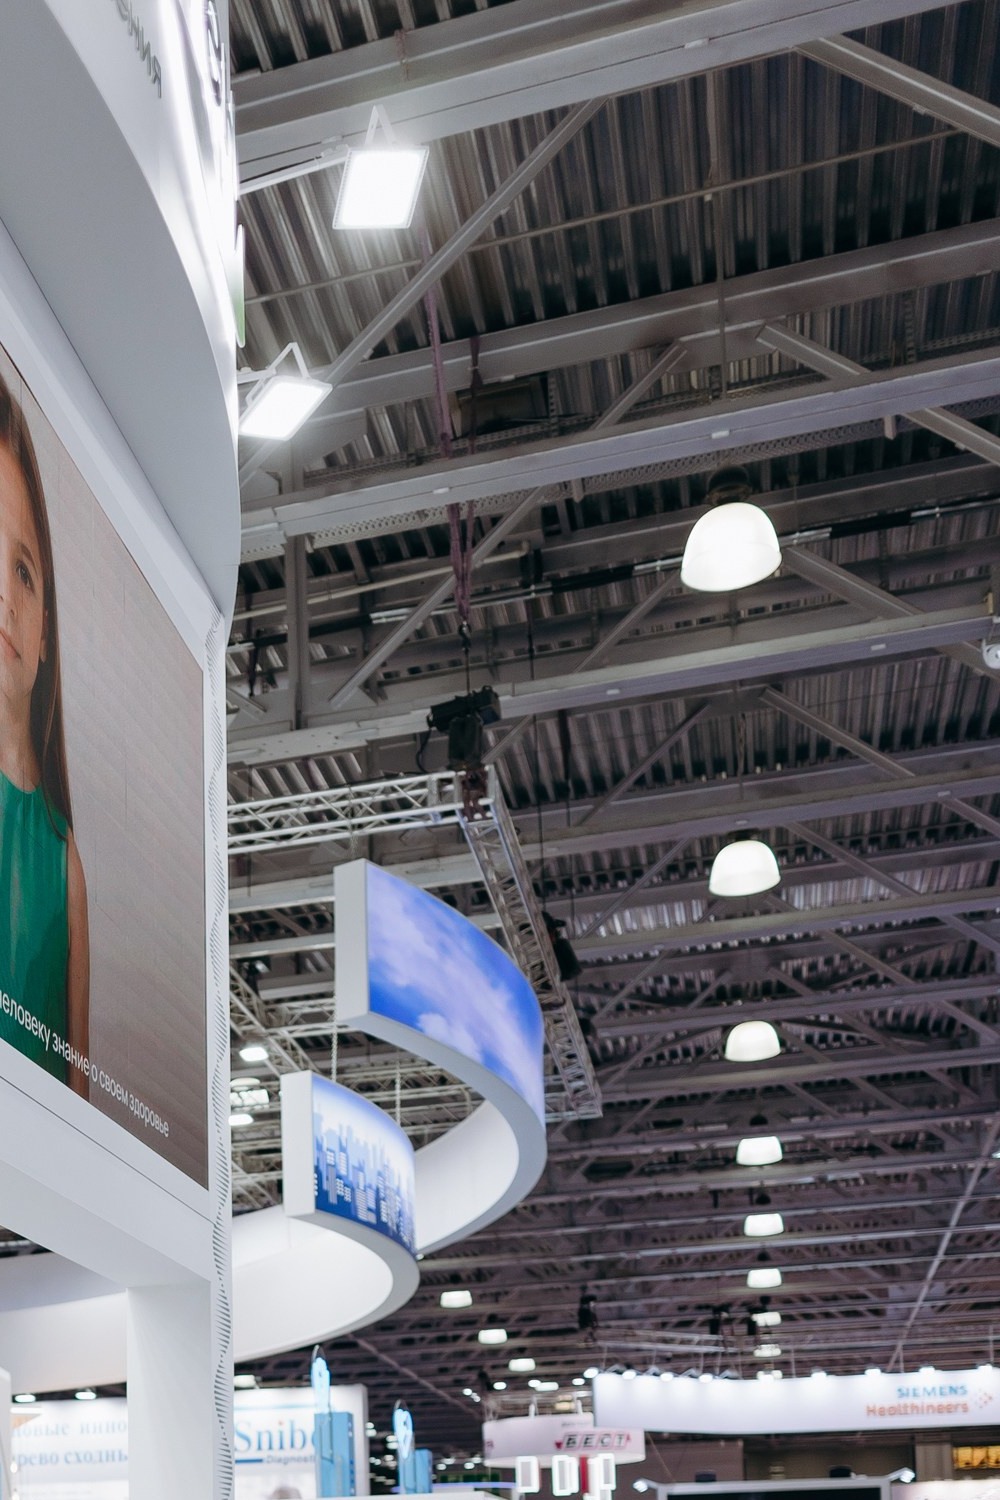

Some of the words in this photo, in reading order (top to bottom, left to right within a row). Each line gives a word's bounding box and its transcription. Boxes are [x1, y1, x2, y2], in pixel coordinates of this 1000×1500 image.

[52, 1032, 90, 1077] знание
[91, 1063, 98, 1083] о
[99, 1070, 129, 1107] своем
[129, 1093, 170, 1138] здоровье
[897, 1384, 968, 1399] SIEMENS
[866, 1400, 969, 1417] Healthineers
